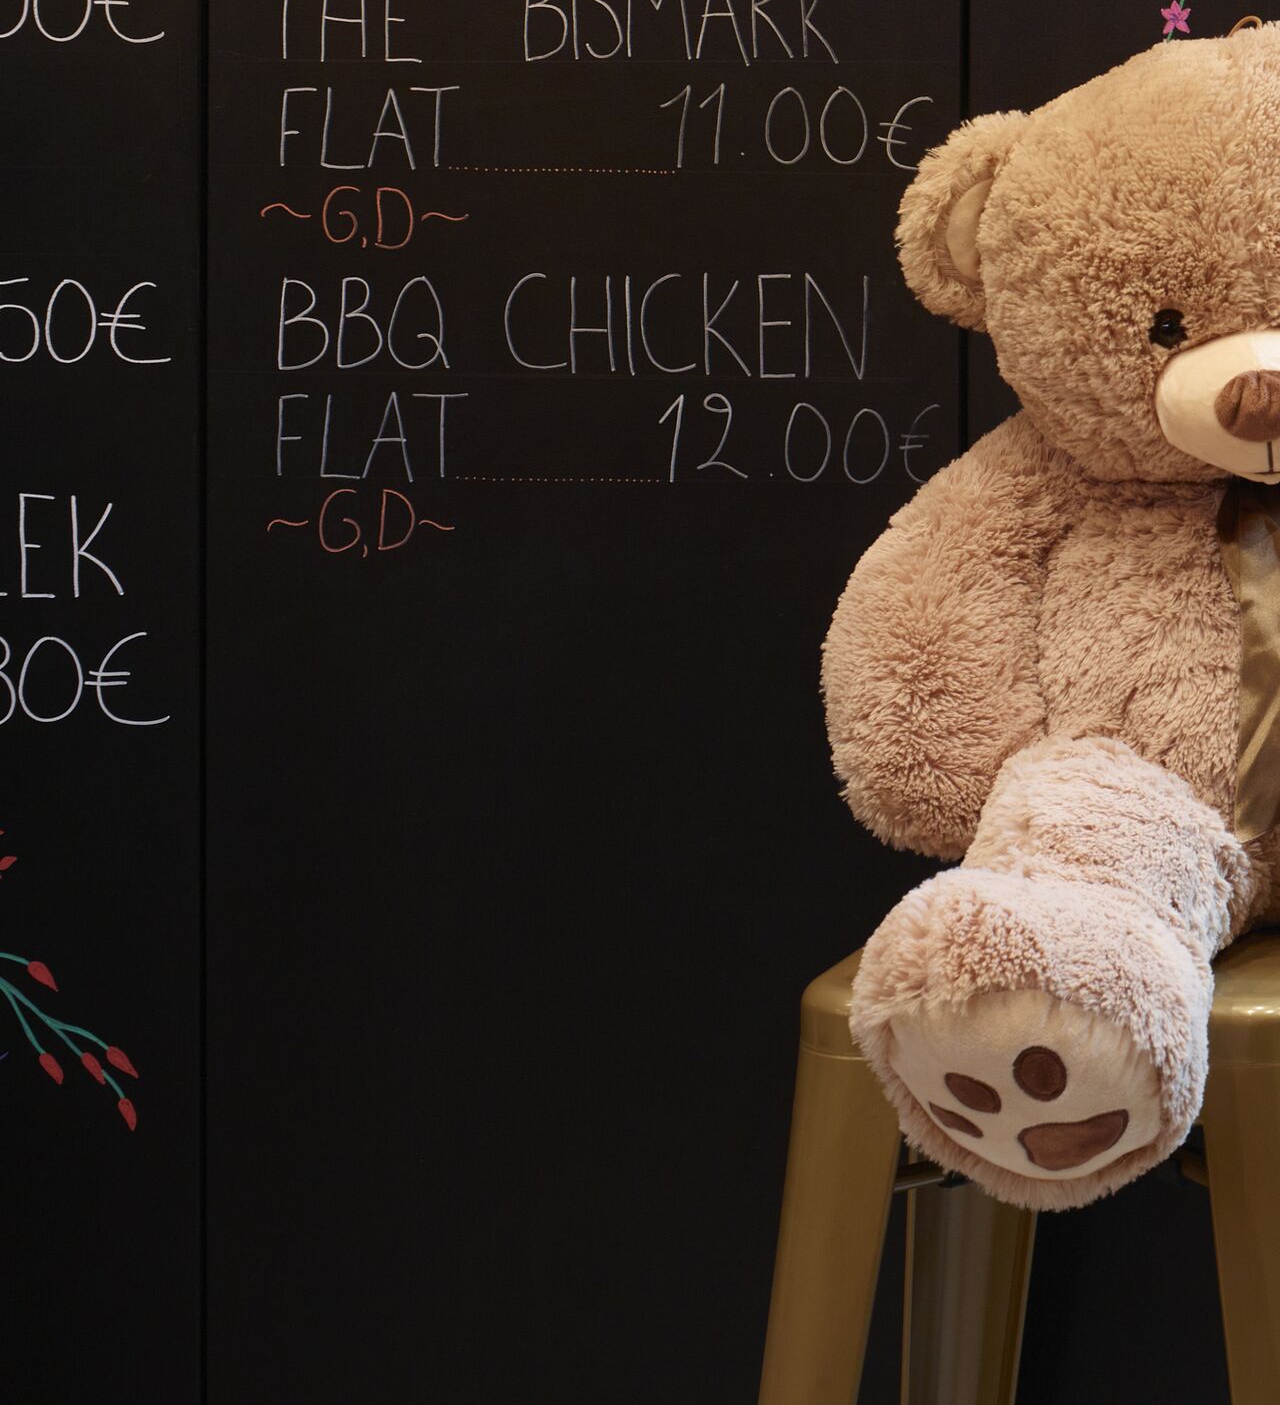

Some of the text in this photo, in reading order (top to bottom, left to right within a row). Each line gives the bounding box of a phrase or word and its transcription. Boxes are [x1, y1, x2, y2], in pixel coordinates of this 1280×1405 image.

[280, 83, 934, 170] FLAT 11.00€
[278, 273, 868, 379] BBQ CHICKEN
[277, 393, 941, 484] FLAT 12.00€
[0, 494, 124, 599] EK
